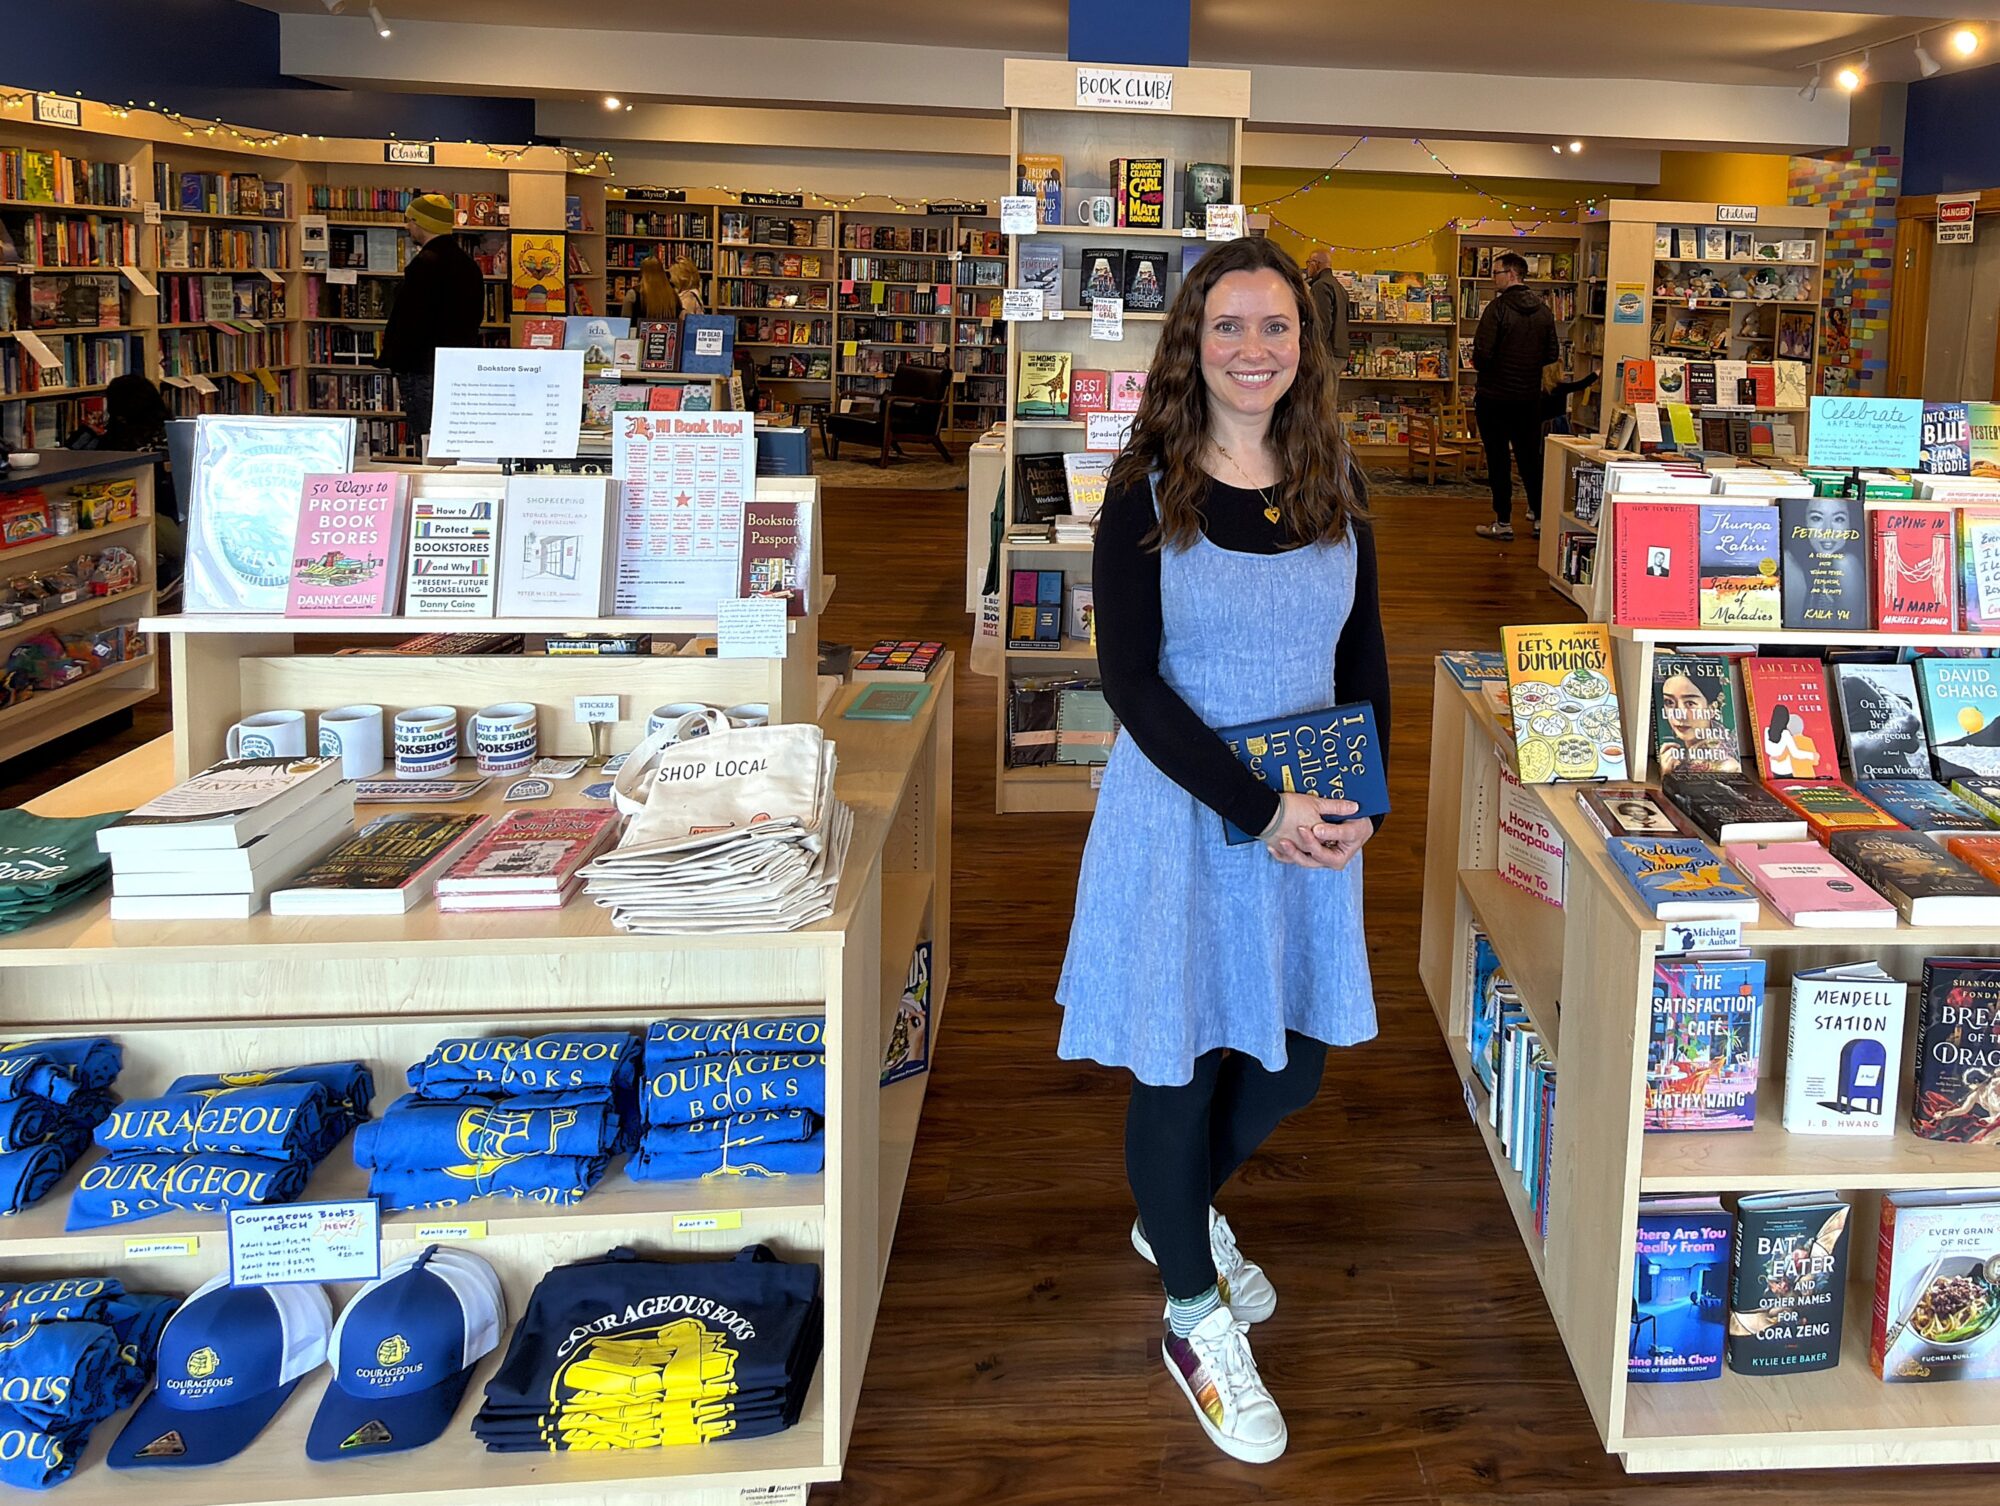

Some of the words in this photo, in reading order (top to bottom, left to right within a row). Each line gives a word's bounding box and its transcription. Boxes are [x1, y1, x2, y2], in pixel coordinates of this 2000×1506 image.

[1080, 76, 1121, 95] BOOK
[1125, 78, 1171, 100] CLUB!
[391, 147, 430, 160] Classics
[1130, 170, 1162, 178] CRAWLER
[1022, 179, 1059, 193] BACKMAN
[1129, 178, 1161, 198] CARL
[642, 190, 669, 200] Mystery
[1129, 198, 1161, 217] MATT
[1941, 207, 1970, 217] DANGER
[1128, 301, 1159, 309] SOCIETY
[477, 365, 516, 373] Bookstore
[518, 365, 542, 374] Swag!
[1075, 380, 1101, 392] BEST
[1821, 399, 1914, 422] Celebrate
[1923, 412, 1945, 422] INTO
[1947, 409, 1965, 420] THE
[674, 419, 709, 433] Book
[713, 419, 743, 437] Hop!
[1854, 420, 1883, 433] Heritage
[1924, 421, 1967, 444] BLUE
[1932, 450, 1963, 461] EMMA
[1931, 459, 1967, 475] BRODIE
[1027, 468, 1065, 481] Atomic
[311, 483, 328, 496] 50
[334, 480, 374, 496] Ways
[377, 481, 388, 493] to
[1030, 482, 1066, 496] Habits
[309, 498, 388, 512] PROTECT
[436, 507, 457, 515] How
[458, 507, 467, 515] to
[319, 515, 375, 528] BOOK
[748, 513, 801, 527] Bookstore
[1703, 513, 1773, 534] Jhumpa
[1887, 515, 1926, 529] CRYING
[1931, 518, 1945, 528] IN
[435, 525, 469, 534] Protect
[1792, 526, 1860, 541] FETISHIZED
[310, 531, 378, 545] STORES
[752, 532, 799, 549] Passport
[414, 542, 489, 553] BOOKSTORES
[1714, 536, 1768, 555] Lahiri
[432, 563, 449, 572] and
[451, 563, 471, 574] Why
[1702, 579, 1775, 597] Interpreter
[297, 595, 342, 605] DANNY
[344, 594, 377, 605] CAINE
[420, 600, 449, 610] Danny
[451, 600, 476, 609] Caine
[1734, 593, 1745, 608] of
[1893, 598, 1904, 611] H
[1907, 602, 1941, 612] MART
[1710, 607, 1773, 622] Maladies
[1518, 639, 1553, 652] LET'S
[1559, 638, 1600, 651] MAKE
[1518, 650, 1606, 672] DUMPLINGS!
[1758, 664, 1784, 673] AMY
[1791, 663, 1816, 672] TAN
[1657, 664, 1691, 677] LISA
[1697, 663, 1725, 676] SEE
[1939, 669, 1990, 683] DAVID
[1777, 694, 1794, 702] JOY
[1797, 694, 1821, 702] LUCK
[1936, 685, 1998, 698] CHANG
[1860, 700, 1876, 709] On
[1661, 707, 1688, 720] LADY
[1691, 708, 1722, 721] TAN'S
[1870, 709, 1898, 719] We're
[494, 724, 512, 732] MY
[1870, 720, 1902, 732] Briefly
[412, 733, 443, 742] FROM
[501, 729, 530, 741] FROM
[1695, 728, 1730, 741] CIRCLE
[1866, 730, 1912, 743] Gorgeous
[1270, 729, 1291, 758] In
[1346, 734, 1368, 776] See
[1672, 748, 1687, 760] OF
[1688, 748, 1727, 761] WOMEN
[658, 763, 706, 782] SHOP
[715, 758, 769, 777] LOCAL
[1863, 765, 1895, 775] Ocean
[1895, 765, 1925, 777] Vuong
[1509, 811, 1534, 832] How
[1536, 822, 1550, 839] To
[1499, 819, 1563, 858] Menopause
[1632, 843, 1702, 858] Relative
[1863, 841, 1925, 851] GRACE
[1884, 851, 1945, 860] KINGS
[1637, 858, 1719, 875] Strangers
[1508, 862, 1532, 883] How
[1535, 874, 1549, 891] To
[1692, 927, 1736, 939] Michigan
[1708, 937, 1737, 946] Author
[1694, 974, 1721, 990] THE
[1653, 995, 1756, 1013] SATISFACTION
[1814, 990, 1892, 1006] MENDELL
[1814, 1015, 1887, 1032] STATION
[1968, 1033, 1985, 1043] OF
[689, 1078, 799, 1119] BOOKS
[1653, 1093, 1701, 1109] KATHY
[1705, 1092, 1746, 1108] WANG
[1838, 1119, 1880, 1128] HWANG
[235, 1211, 313, 1226] Courageous
[318, 1209, 355, 1220] Books
[264, 1222, 308, 1232] MERCH
[1674, 1228, 1699, 1241] Are
[1701, 1227, 1727, 1240] You
[1929, 1228, 1961, 1237] EVERY
[1963, 1227, 1994, 1236] GRAIN
[1680, 1241, 1715, 1253] From
[1757, 1236, 1797, 1255] BAT
[1940, 1238, 1955, 1247] OF
[1957, 1237, 1980, 1246] RICE
[1773, 1256, 1835, 1277] EATER
[1794, 1280, 1815, 1291] AND
[1759, 1296, 1795, 1308] OTHER
[1797, 1293, 1832, 1306] NAMES
[1777, 1311, 1798, 1322] FOR
[556, 1294, 714, 1360] COURAGEOUS
[709, 1304, 756, 1342] BOOKS
[1756, 1327, 1793, 1341] CORA
[1796, 1323, 1830, 1339] ZENG
[1654, 1355, 1686, 1366] Hsieh
[1688, 1354, 1717, 1366] Chou
[1752, 1356, 1779, 1366] KYLIE
[1781, 1355, 1797, 1365] LEE
[1800, 1352, 1828, 1364] BAKER
[356, 1363, 424, 1377] COURAGEOUS
[166, 1376, 235, 1391] COURAGEOUS
[369, 1375, 405, 1384] BOOKS
[180, 1387, 215, 1395] BOOKS
